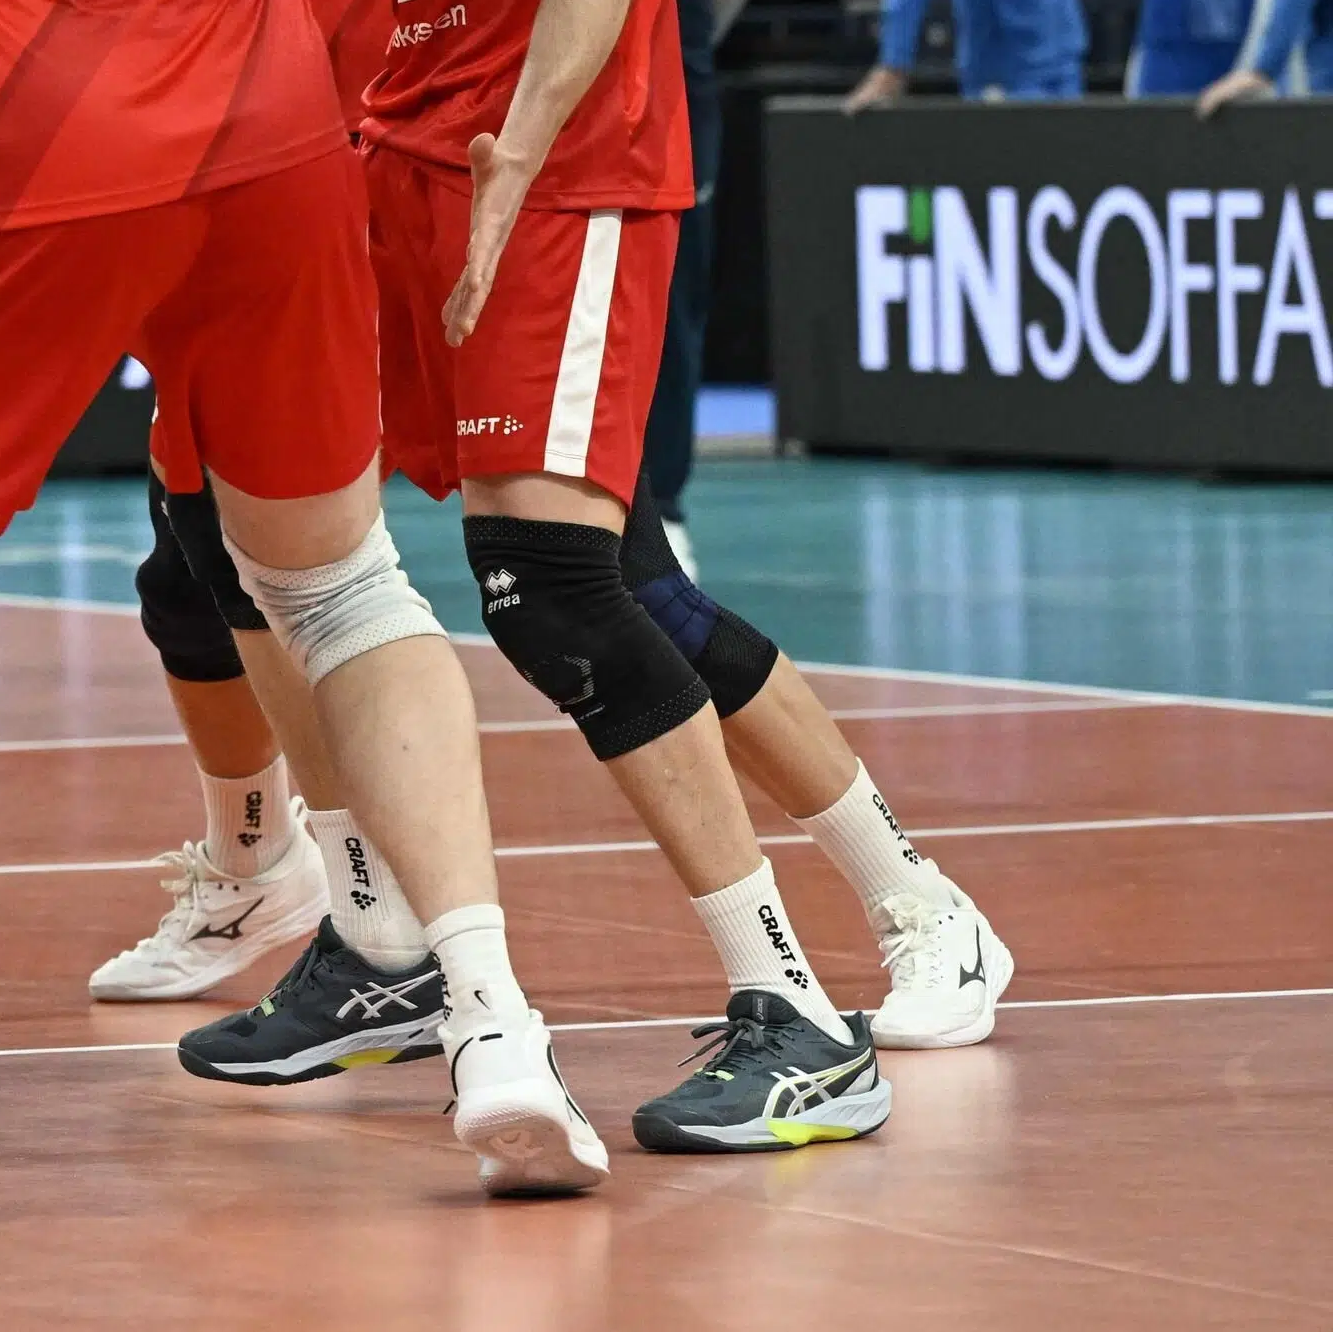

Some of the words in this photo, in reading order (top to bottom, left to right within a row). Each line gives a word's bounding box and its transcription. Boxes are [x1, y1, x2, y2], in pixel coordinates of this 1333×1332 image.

[872, 794, 907, 841] CRAFT
[344, 837, 371, 888] CRAFT
[757, 904, 797, 963] CRAFT
